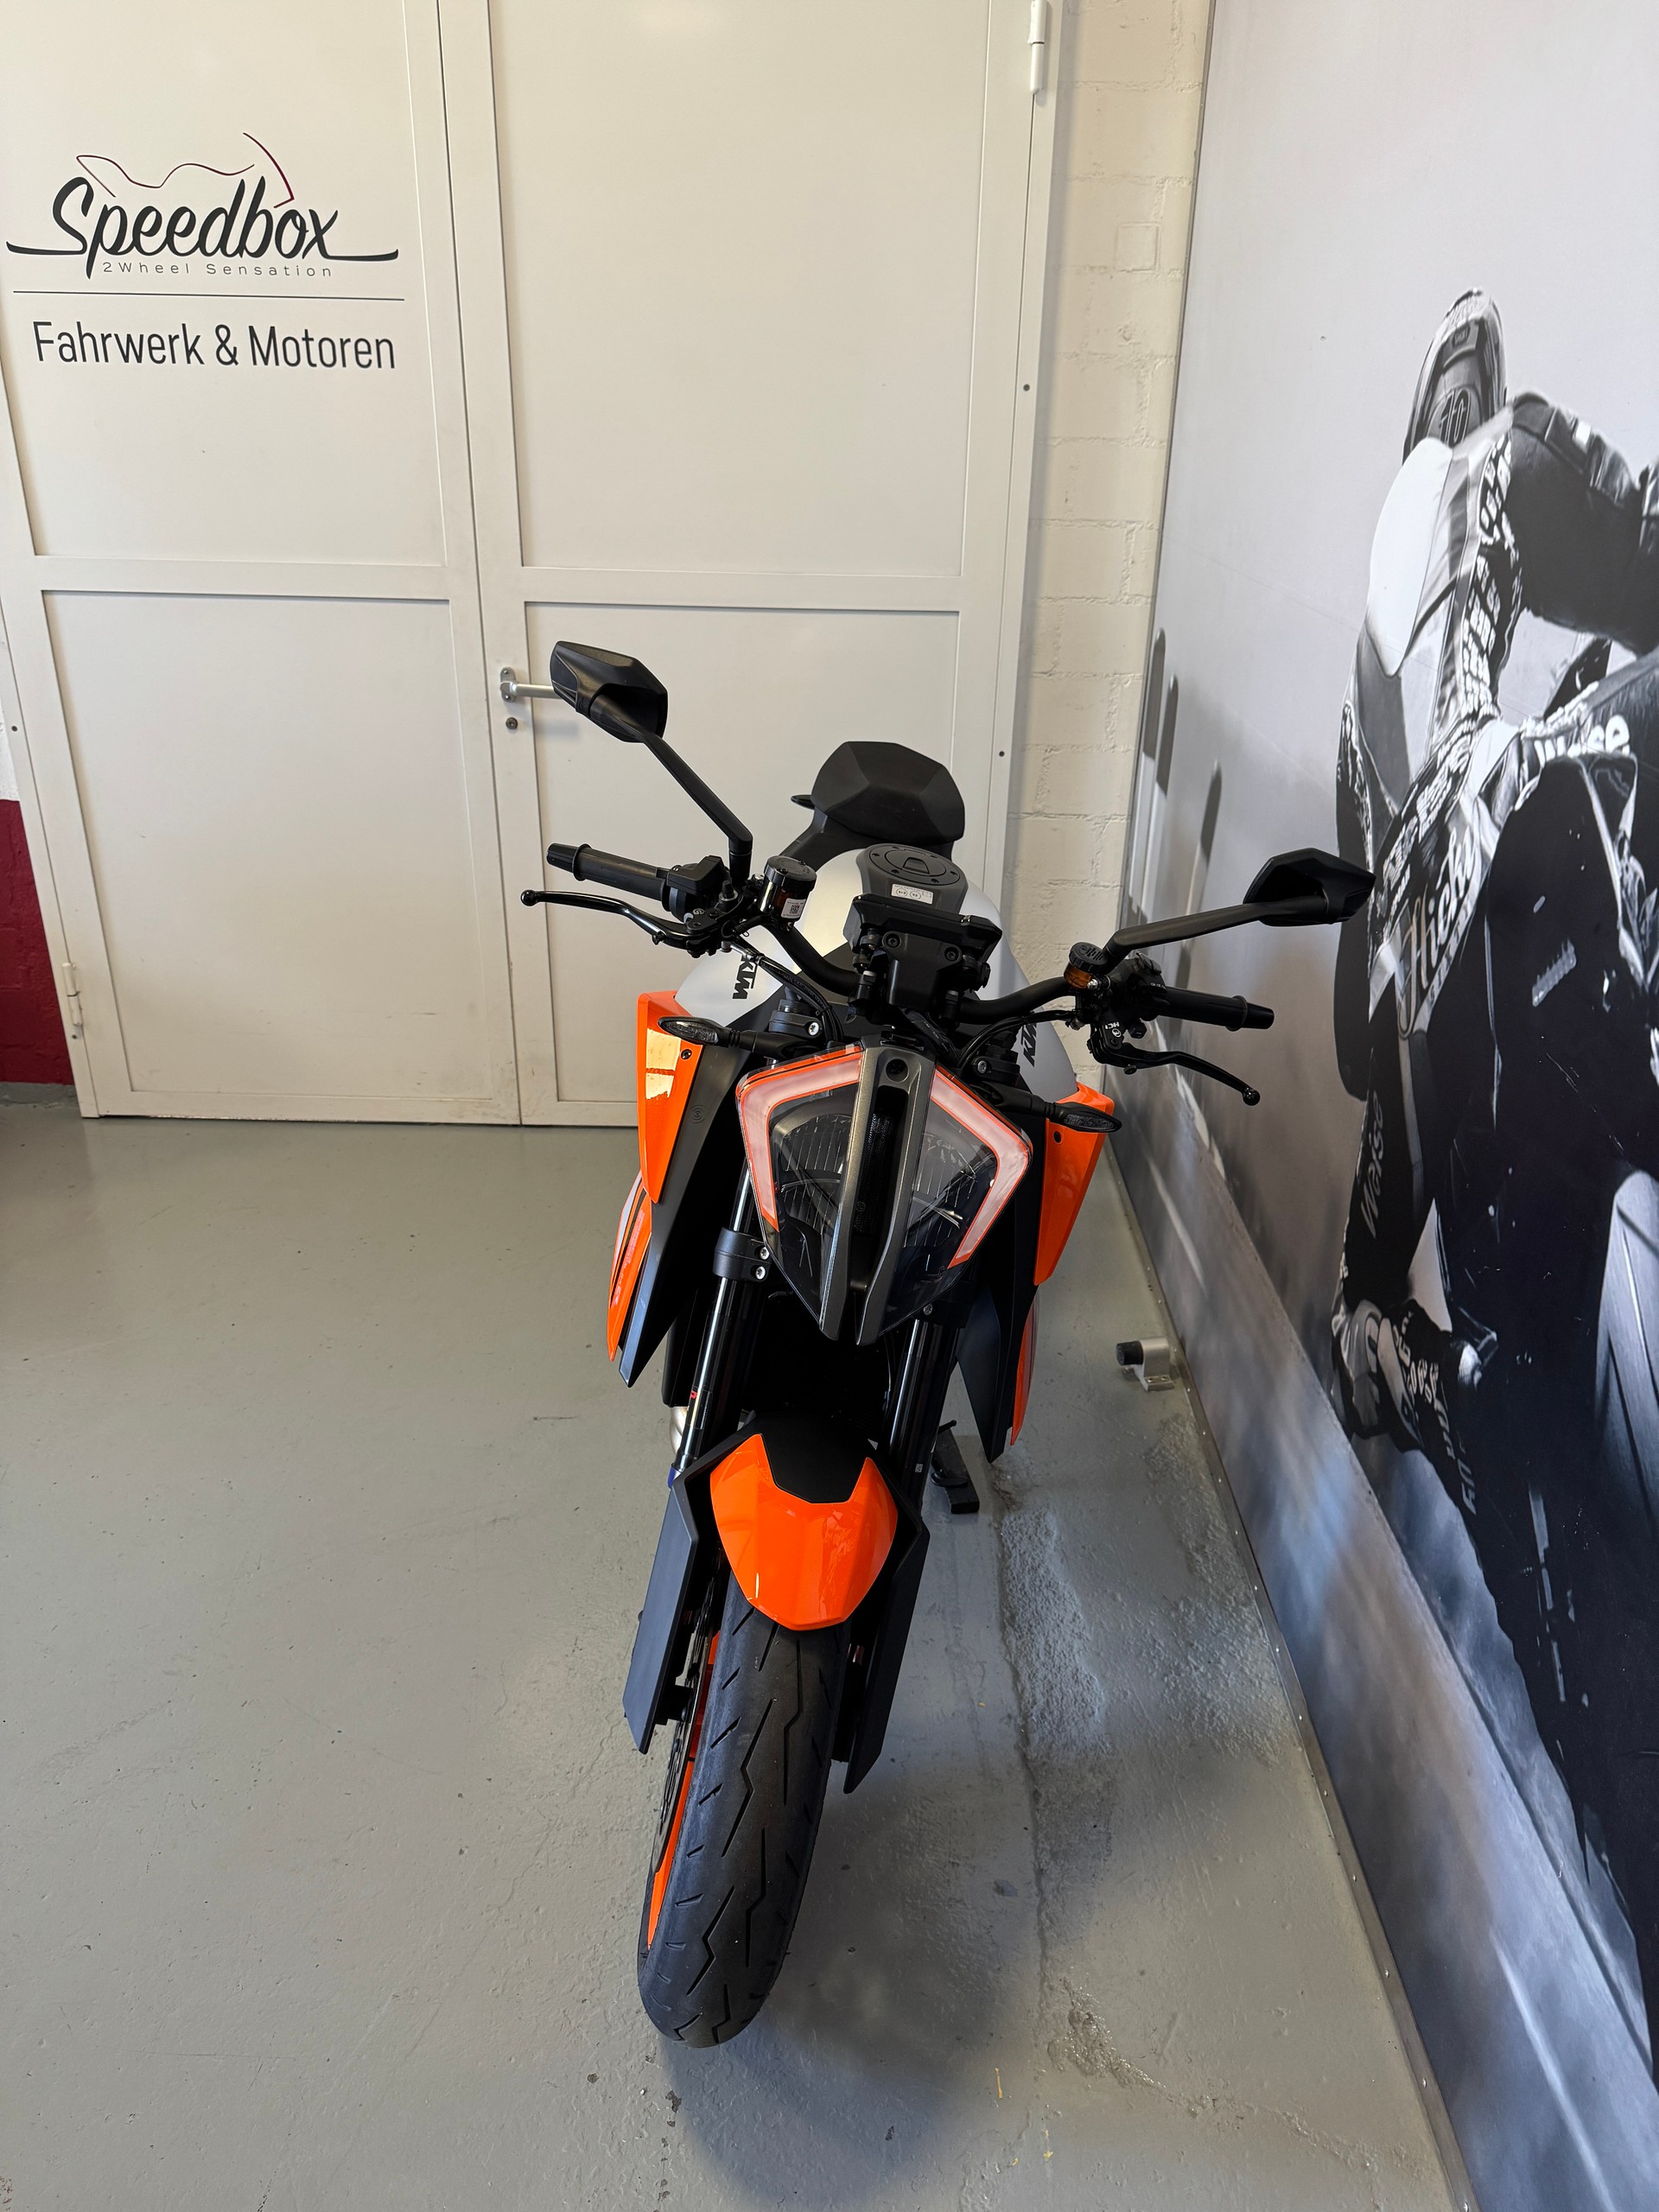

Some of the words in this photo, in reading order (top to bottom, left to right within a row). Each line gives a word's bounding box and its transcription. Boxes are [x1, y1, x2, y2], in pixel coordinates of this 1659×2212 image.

[6, 175, 399, 279] Speedbox
[102, 261, 190, 275] 2Wheel
[206, 263, 332, 276] Sensation
[32, 321, 206, 365] Fahrwerk
[215, 324, 239, 365] &
[248, 325, 396, 369] Motoren
[732, 953, 759, 1000] KTM
[1361, 1090, 1383, 1239] Weise
